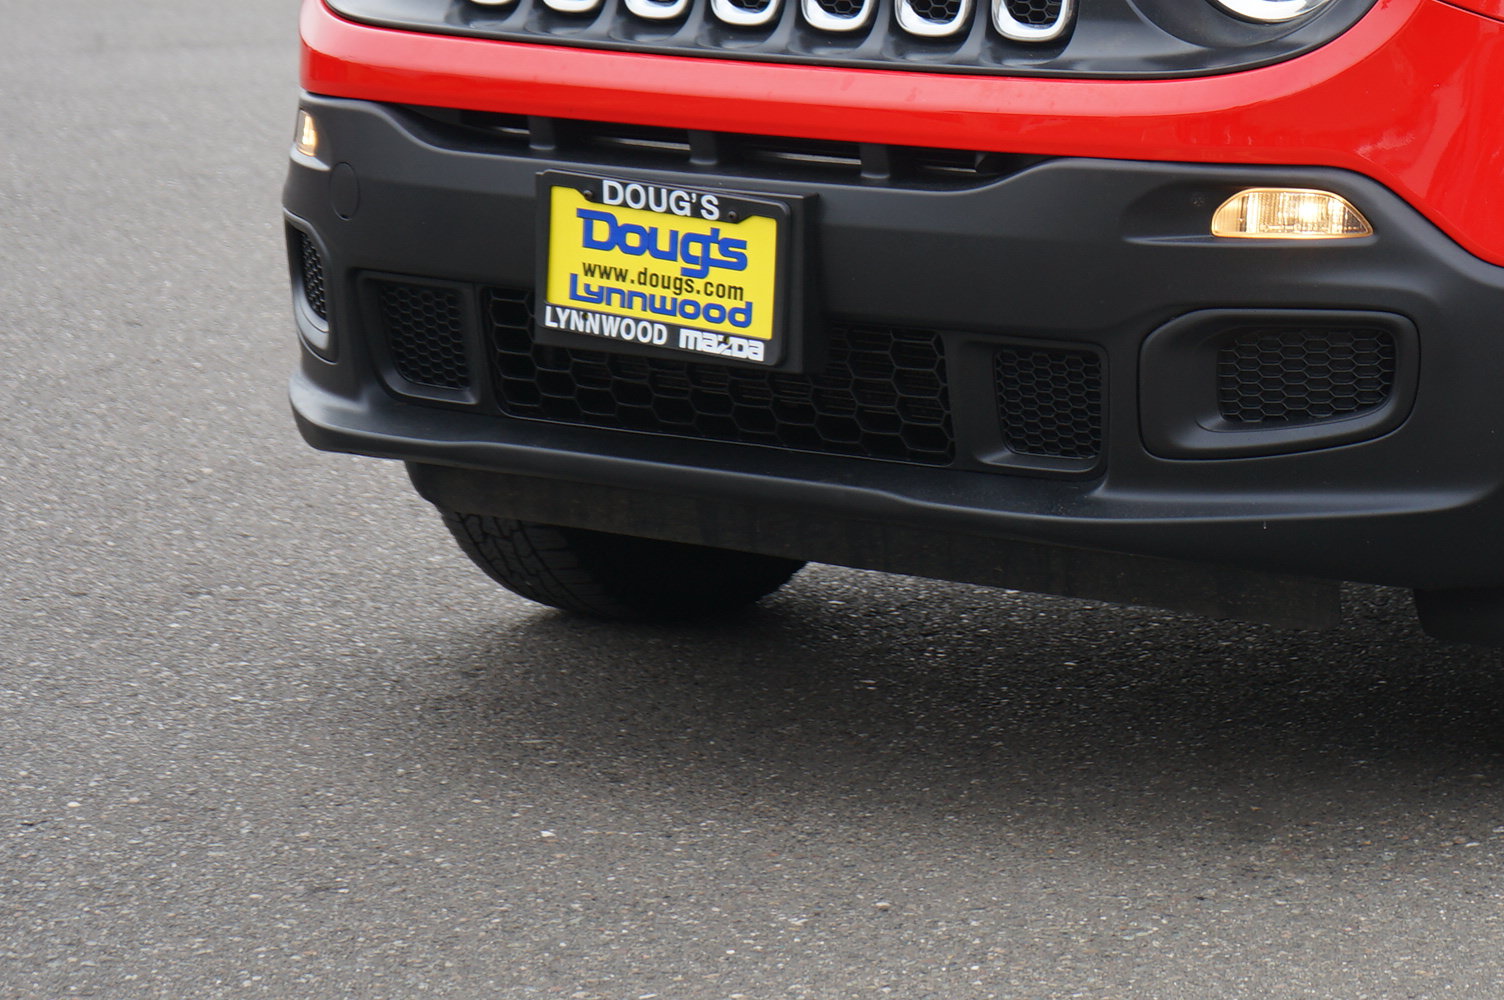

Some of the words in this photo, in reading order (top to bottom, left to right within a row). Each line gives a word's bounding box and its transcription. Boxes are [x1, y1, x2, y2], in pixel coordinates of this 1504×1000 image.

[602, 179, 720, 220] DOUG'S
[576, 208, 748, 279] Doug's
[569, 273, 753, 329] Lynnwood
[582, 261, 744, 301] www.dougs.com
[544, 305, 668, 345] LYNNWOOD
